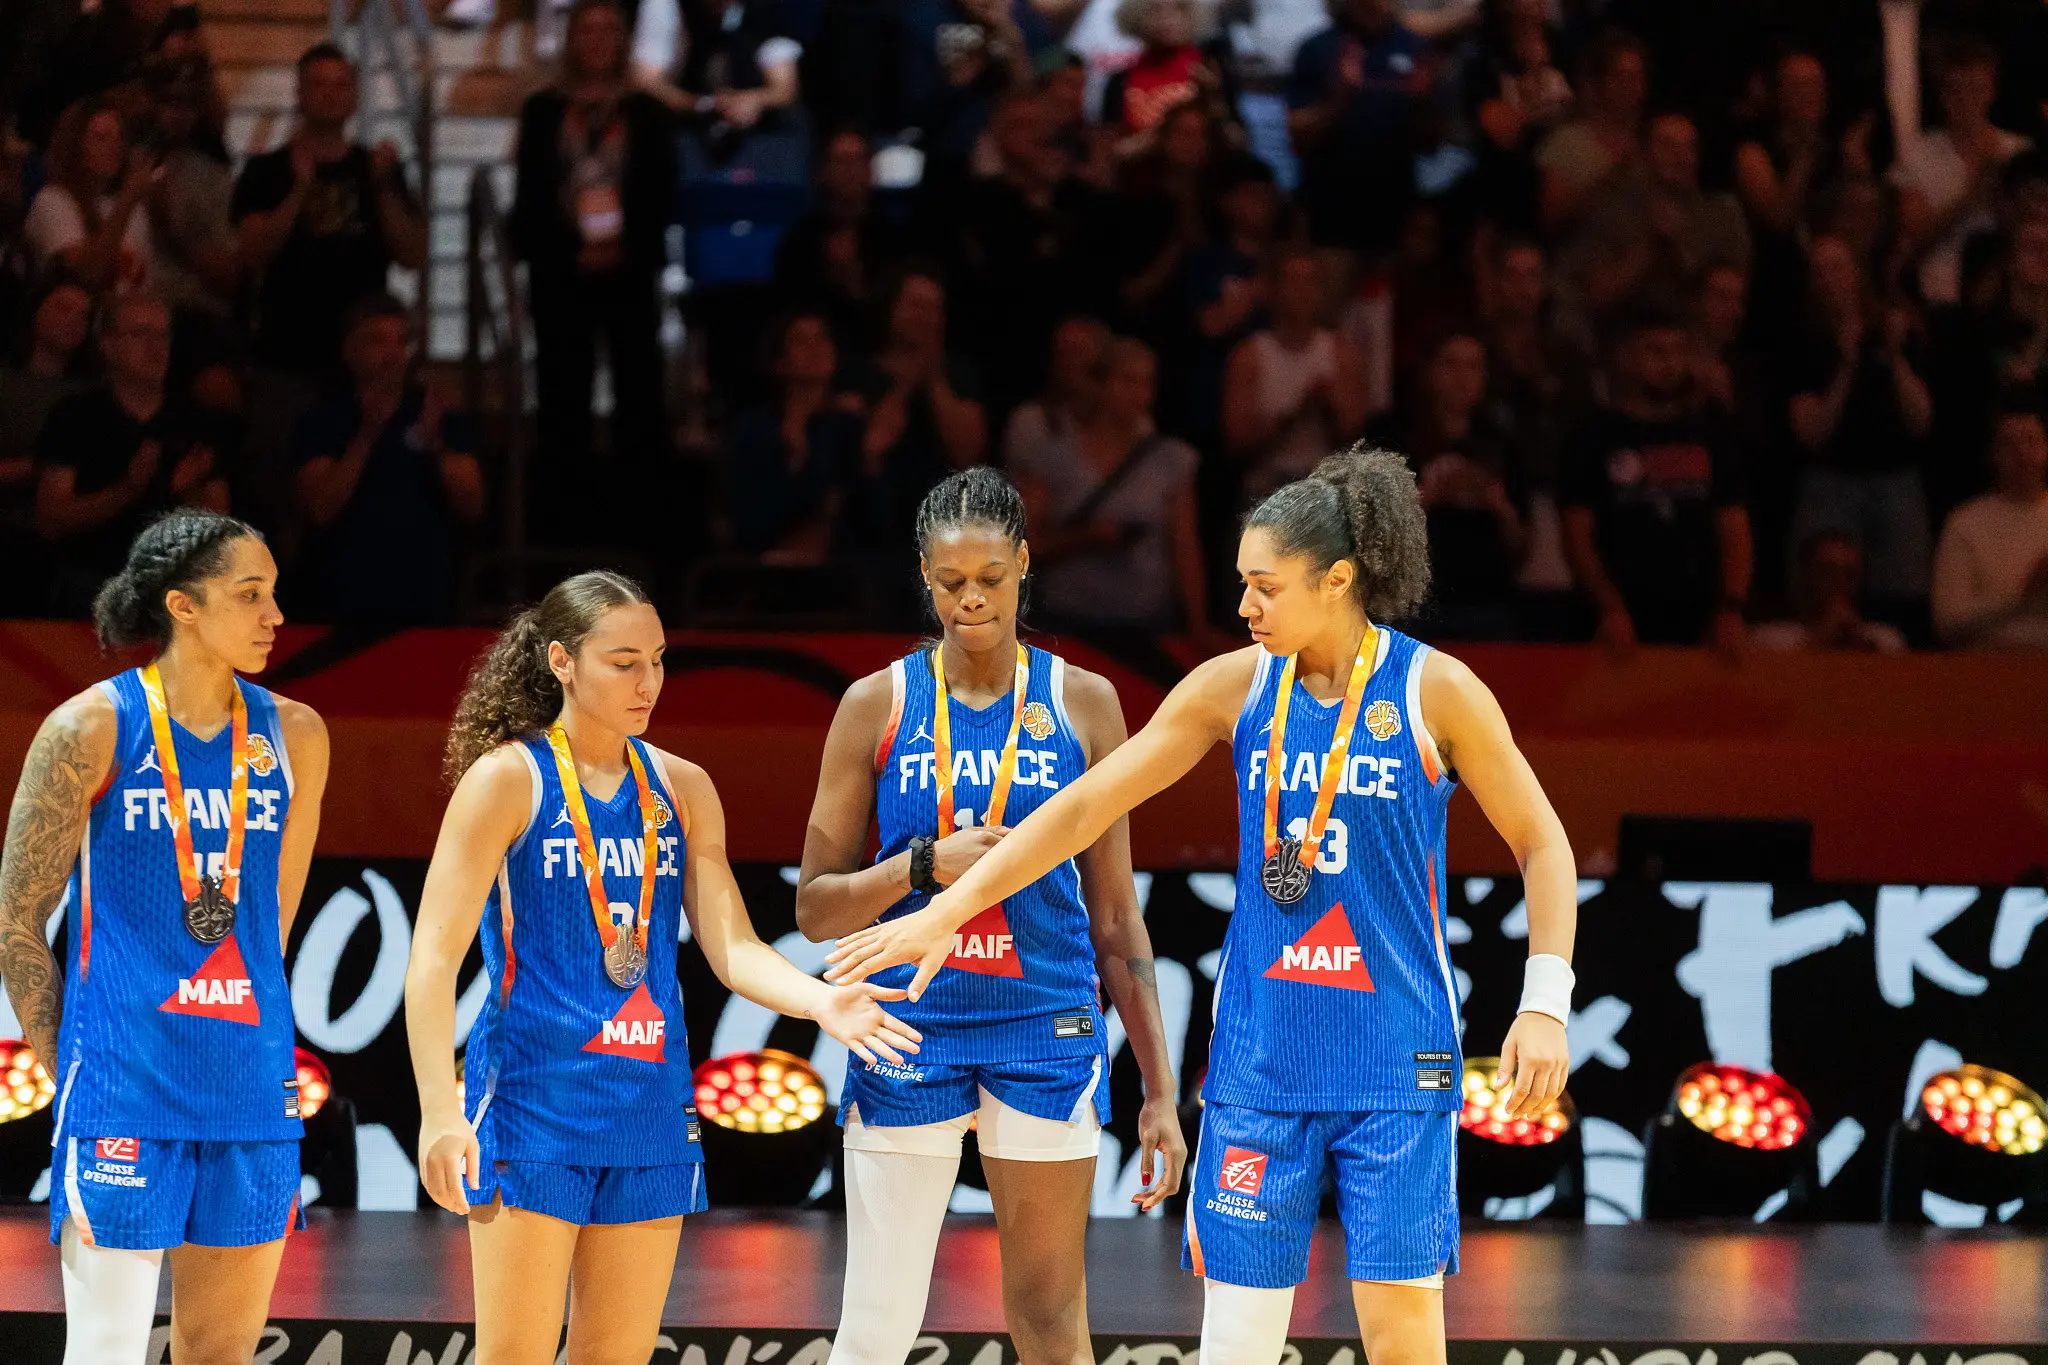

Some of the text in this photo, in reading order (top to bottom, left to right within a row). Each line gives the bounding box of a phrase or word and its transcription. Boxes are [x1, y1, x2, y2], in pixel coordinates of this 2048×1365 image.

[899, 749, 1058, 794] FRANCE
[123, 788, 281, 832] FRANCE
[1282, 945, 1361, 971] MAIF
[178, 978, 252, 1005] MAIF
[602, 1020, 665, 1045] MAIF
[1081, 1021, 1091, 1030] 42
[864, 1062, 925, 1083] D'EPARGNE
[1441, 1075, 1450, 1084] 44
[83, 1169, 148, 1188] D'EPARGNE
[95, 1161, 137, 1176] CAISSE
[1205, 1198, 1268, 1222] D'EPARGNE
[1217, 1192, 1256, 1209] CAISSE
